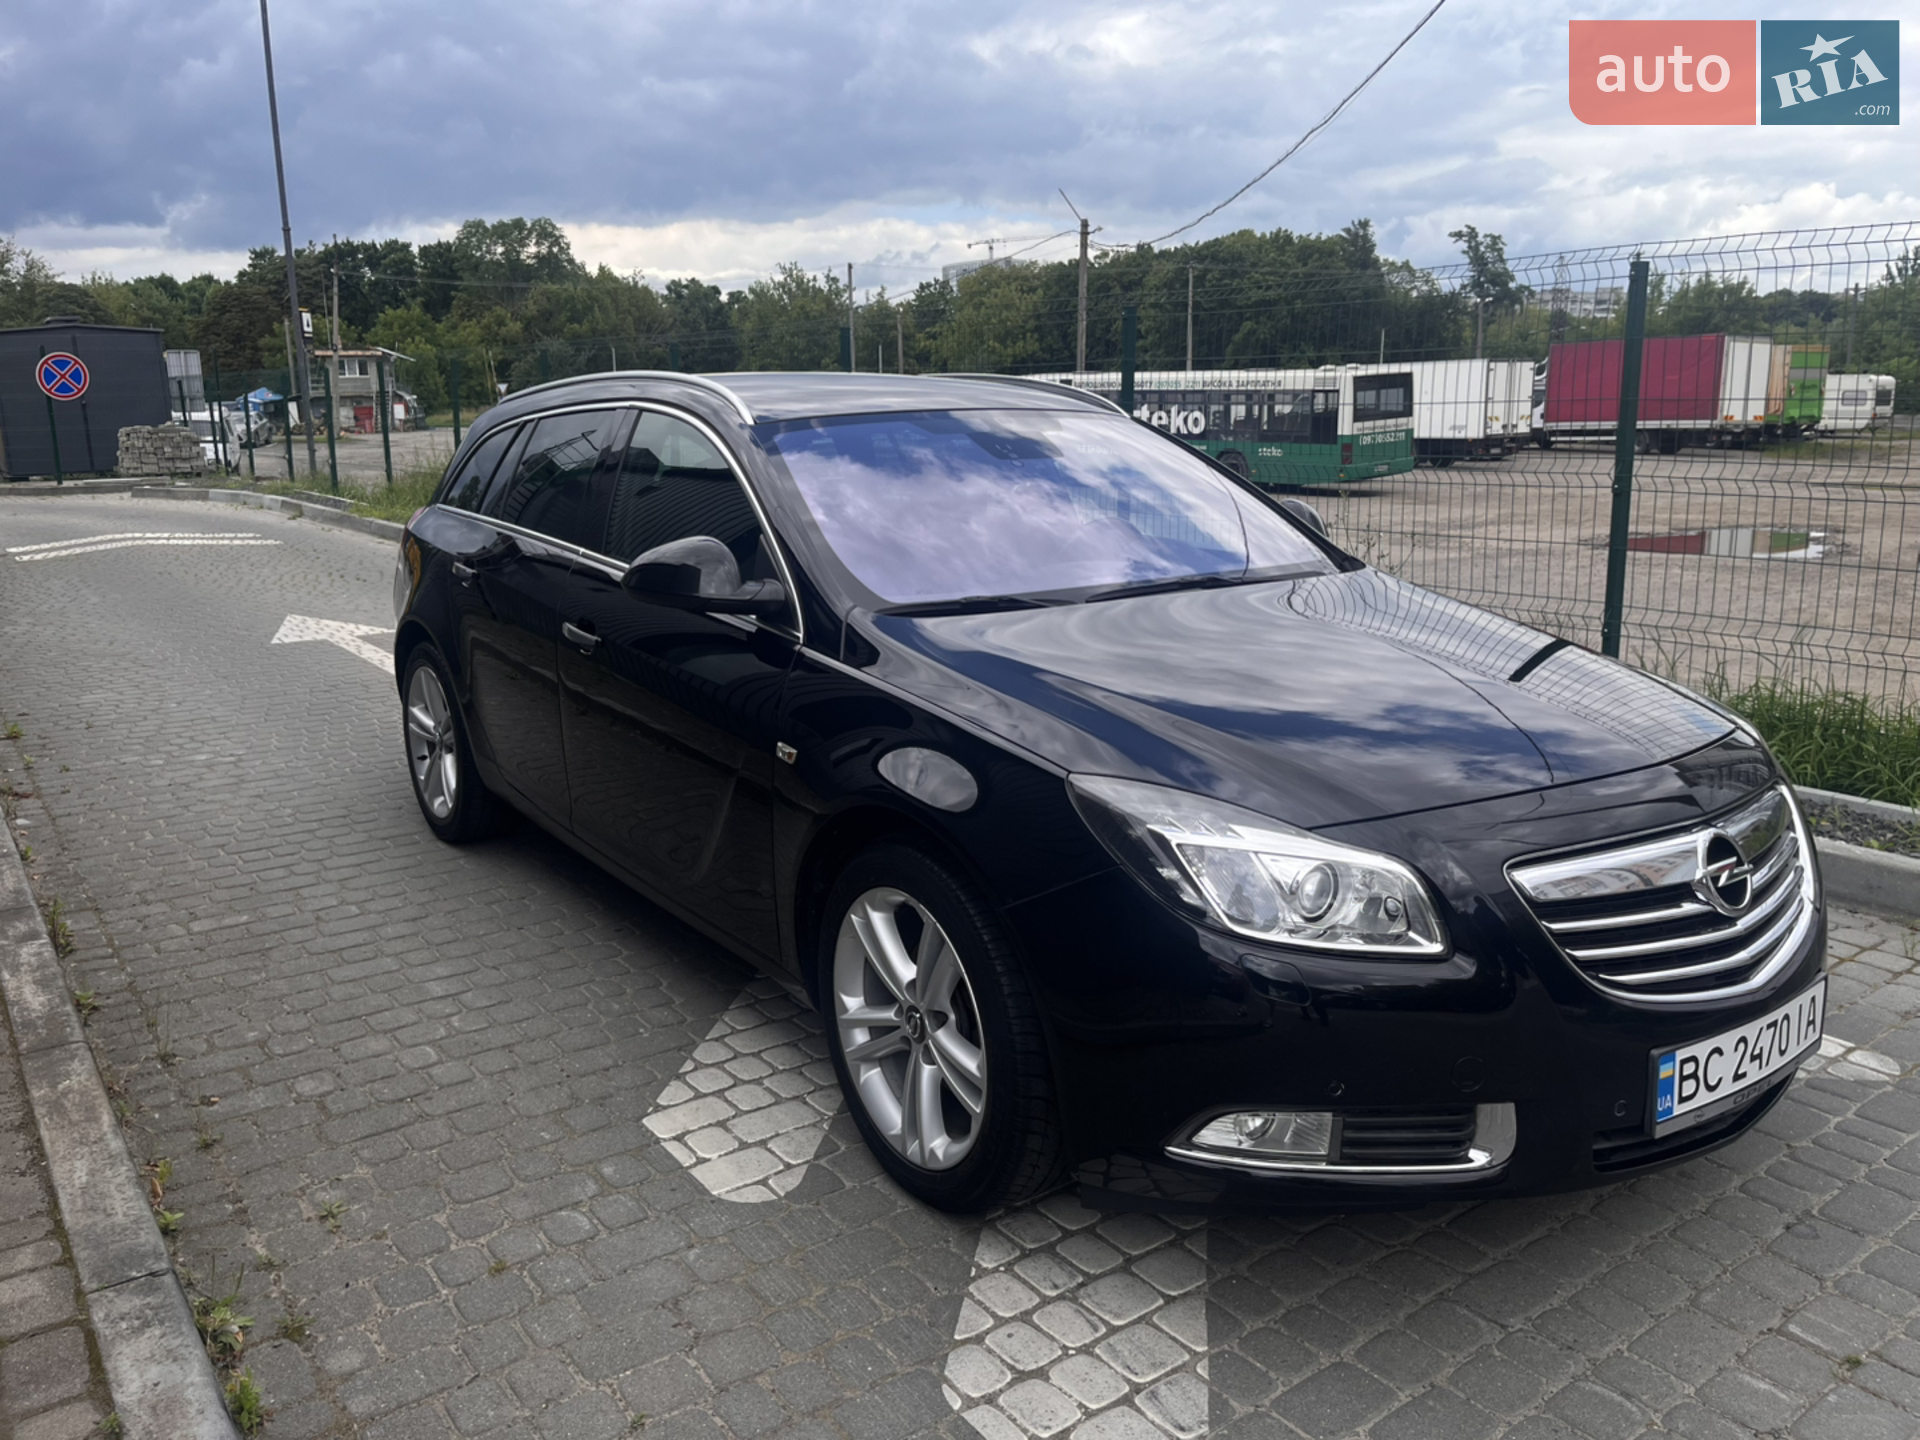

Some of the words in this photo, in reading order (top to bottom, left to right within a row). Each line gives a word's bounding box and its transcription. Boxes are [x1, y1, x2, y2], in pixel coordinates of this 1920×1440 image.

[1202, 379, 1233, 388] ВИСОКА
[1258, 446, 1284, 457] steko
[1677, 1046, 1725, 1105] BC
[1731, 1012, 1791, 1084] 2470
[1796, 994, 1817, 1046] IA
[1657, 1094, 1673, 1112] UA
